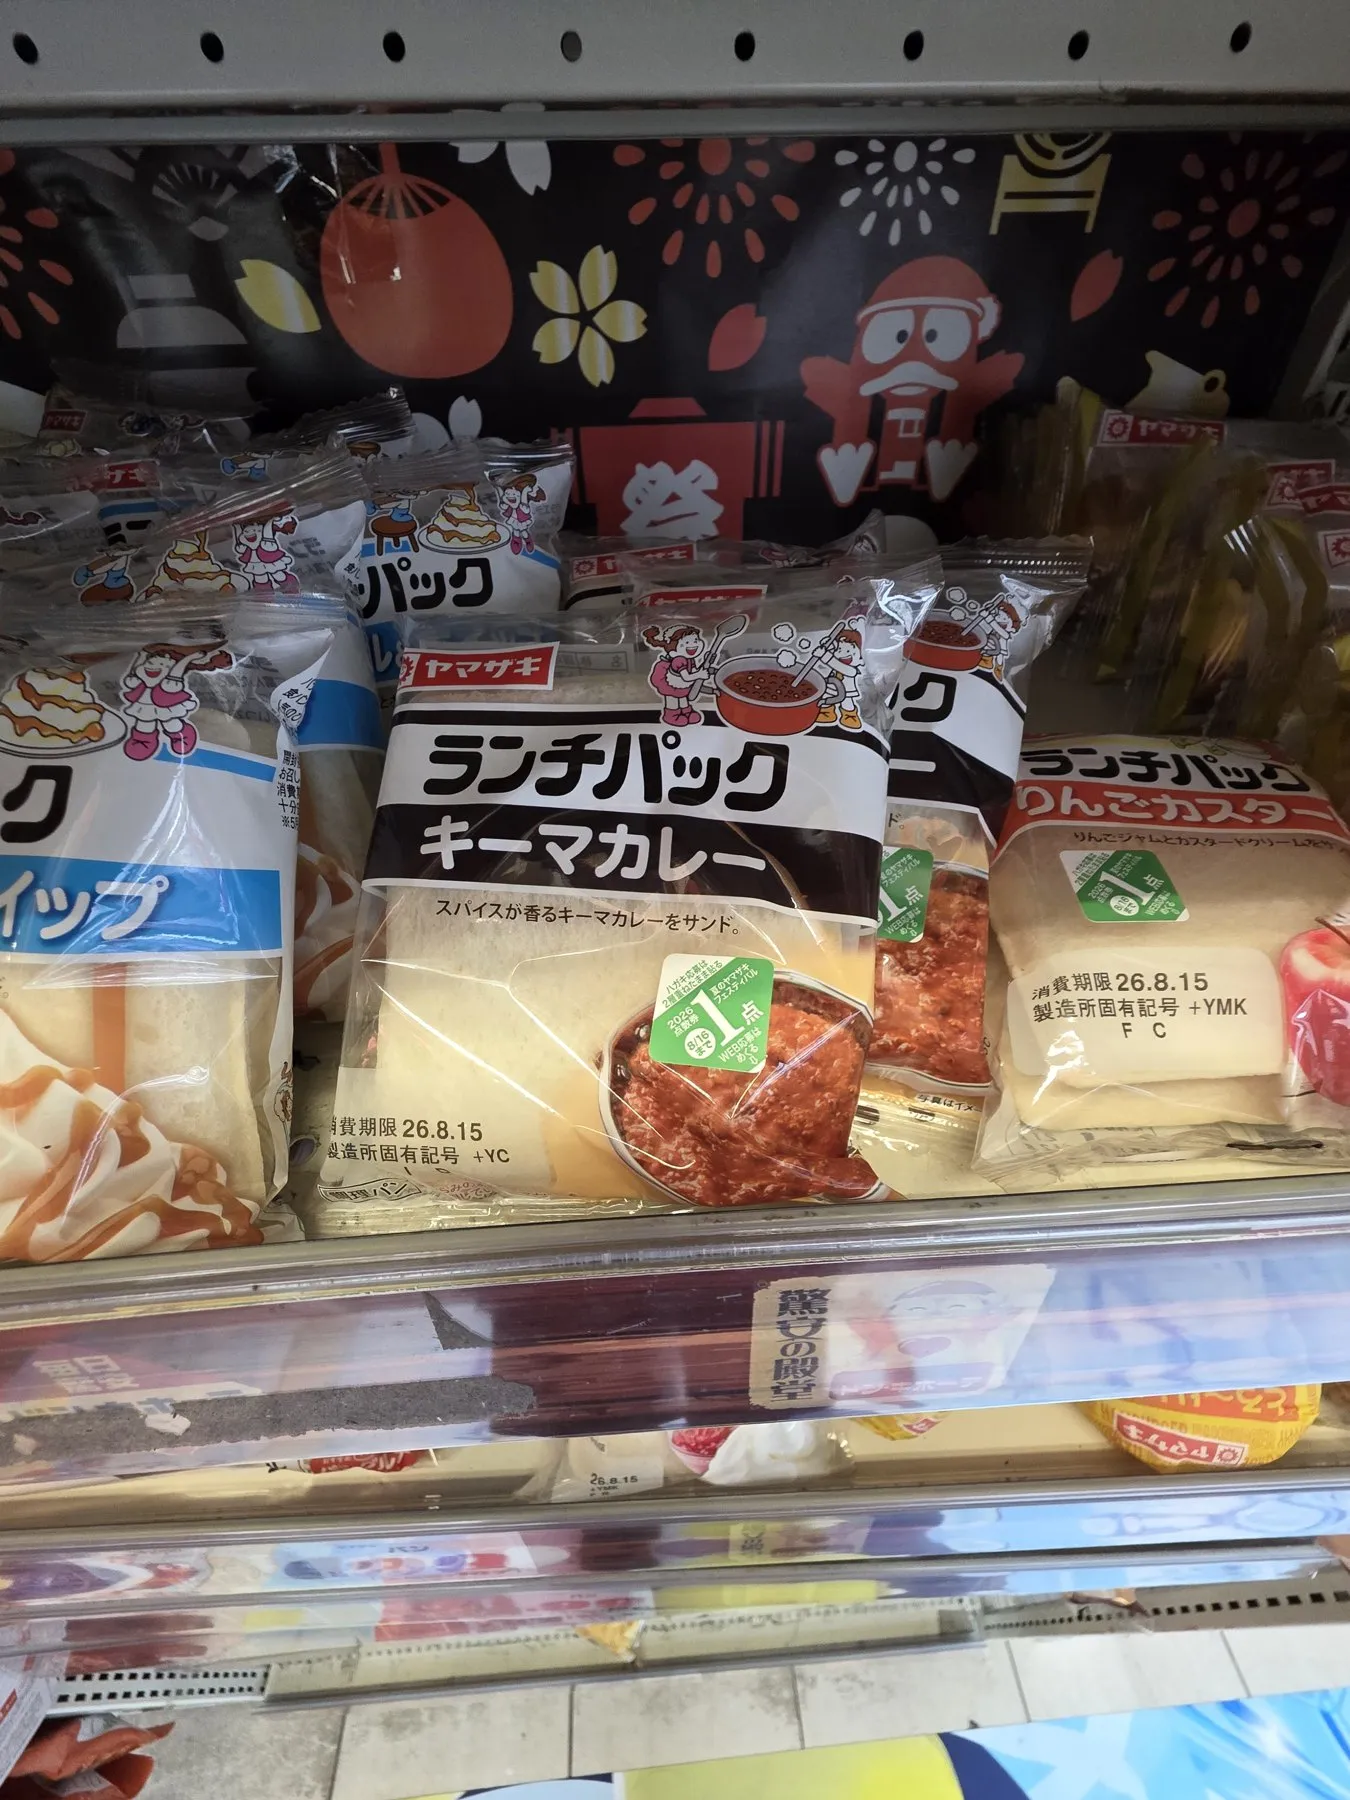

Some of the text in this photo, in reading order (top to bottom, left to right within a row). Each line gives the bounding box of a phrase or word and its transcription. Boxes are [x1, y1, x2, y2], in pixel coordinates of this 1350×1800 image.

[358, 556, 494, 620] パック
[425, 656, 543, 679] ヤマザキ
[900, 671, 957, 723] ク
[422, 729, 790, 813] ランチパック
[1022, 746, 1312, 792] ランチパック
[0, 764, 73, 844] ク
[277, 783, 299, 799] 消費
[1016, 785, 1335, 825] りんごカスター
[419, 814, 768, 883] キーマカレー
[0, 869, 170, 941] イップ
[435, 899, 742, 937] スパイスが香るキーマカレーをサンド。
[709, 963, 750, 996] 夏のヤマザキ
[713, 968, 759, 1004] フェスティバル
[1031, 972, 1209, 1001] 消費期限 26.8.15
[667, 1006, 694, 1029] 2026
[674, 1014, 700, 1037] 点数券
[1033, 997, 1248, 1023] 製造所固有記号 +YMK
[686, 1030, 710, 1051] 8/16
[1121, 1022, 1167, 1039] F C
[694, 1040, 713, 1057] まで
[736, 1045, 759, 1064] めくる
[402, 1119, 484, 1142] 26.8.15
[473, 1148, 511, 1164] +YC
[771, 1287, 832, 1402] 驚安の殿堂
[1122, 1424, 1209, 1459] ヤマザキ
